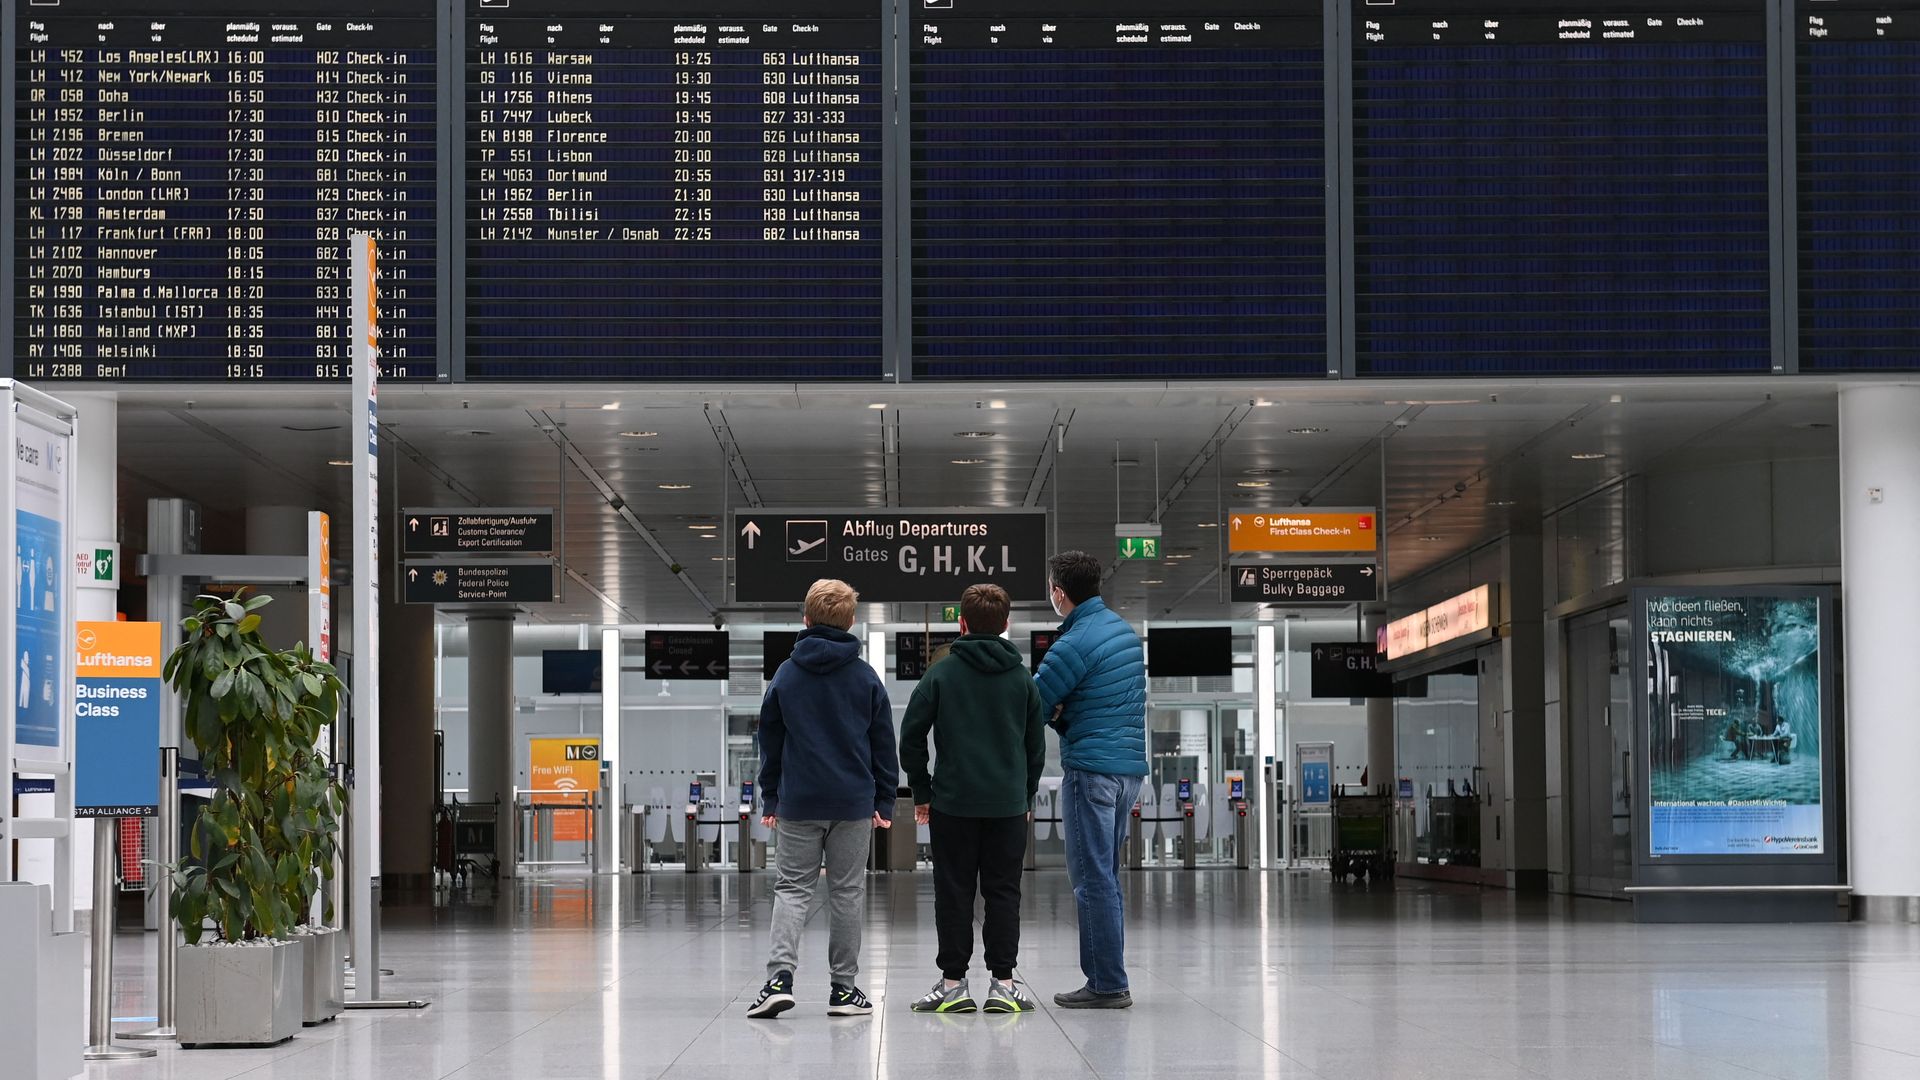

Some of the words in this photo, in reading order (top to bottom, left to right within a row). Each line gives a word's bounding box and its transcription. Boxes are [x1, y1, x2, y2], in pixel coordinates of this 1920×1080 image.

[29, 21, 45, 32] Flug
[97, 21, 114, 30] nach
[150, 21, 166, 31] über
[226, 22, 260, 32] planmäßig
[316, 22, 332, 31] Gate
[1809, 15, 1824, 26] Flug
[1875, 15, 1893, 24] nach
[923, 24, 938, 34] Flug
[990, 23, 1006, 32] nach
[1041, 23, 1057, 32] über
[1115, 22, 1150, 33] planmäßig
[1204, 22, 1220, 31] Gate
[1809, 27, 1828, 38] Flight
[1876, 28, 1885, 36] to
[29, 32, 49, 43] Flight
[98, 34, 106, 42] to
[151, 33, 162, 42] via
[226, 33, 259, 43] scheduled
[271, 34, 304, 43] estimated
[923, 35, 942, 46] Flight
[990, 36, 998, 44] to
[1042, 35, 1053, 43] via
[1116, 34, 1148, 43] scheduled
[1160, 34, 1192, 43] estimated
[480, 51, 495, 65] LH
[504, 51, 533, 65] 1616
[547, 51, 592, 65] Warsaw
[675, 52, 711, 65] 19:25
[792, 52, 860, 66] Lufthansa
[30, 69, 46, 83] LH
[60, 69, 83, 83] 412
[98, 69, 121, 83] New
[129, 69, 211, 83] York/Newark
[228, 70, 264, 84] 16:05
[316, 70, 339, 84] H14
[346, 70, 407, 84] Check-in
[480, 90, 496, 104] LH
[504, 90, 533, 104] 1756
[547, 90, 592, 104] Athens
[675, 91, 711, 104] 19:45
[793, 91, 860, 105] Lufthansa
[30, 108, 46, 122] LH
[54, 108, 83, 122] 1952
[98, 108, 144, 122] Berlin
[228, 109, 264, 123] 17:30
[347, 110, 407, 123] Check-in
[30, 128, 46, 141] LH
[53, 128, 83, 142] 2196
[98, 128, 144, 142] Bremen
[228, 129, 264, 142] 17:30
[347, 129, 407, 143] Check-in
[30, 147, 45, 161] LH
[52, 147, 83, 161] 2022
[98, 147, 172, 161] Düsseldorf
[228, 148, 264, 162] 17:30
[346, 149, 407, 162] Check-in
[480, 149, 496, 162] TP
[510, 149, 531, 162] 551
[547, 149, 593, 163] Lisbon
[674, 149, 711, 163] 20:00
[793, 150, 860, 163] Lufthansa
[480, 188, 496, 201] LH
[504, 188, 533, 201] 1962
[547, 188, 592, 202] Berlin
[674, 188, 711, 202] 21:30
[793, 188, 860, 202] Lufthansa
[30, 206, 45, 220] KL
[54, 206, 83, 220] 1798
[98, 206, 166, 220] Amsterdam
[228, 207, 264, 221] 17:50
[346, 207, 407, 221] Check-in
[480, 207, 496, 221] LH
[503, 207, 533, 221] 2558
[548, 207, 599, 221] Tbilisi
[674, 208, 712, 221] 22:15
[763, 208, 786, 221] H38
[793, 208, 860, 221] Lufthansa
[29, 245, 45, 259] LH
[52, 246, 83, 259] 2102
[97, 246, 158, 260] Hannover
[227, 246, 264, 260] 18:05
[29, 285, 45, 298] EW
[53, 285, 83, 299] 1990
[97, 285, 135, 299] Palma
[143, 285, 218, 299] d.Mallorca
[227, 285, 264, 299] 18:20
[29, 344, 44, 357] AY
[53, 344, 82, 358] 1406
[97, 344, 156, 358] Helsinki
[227, 344, 264, 358] 18:50
[26, 445, 38, 466] care
[458, 516, 537, 527] Zollabfertigung/Ausfuhr
[1269, 518, 1311, 526] Lufthansa
[458, 527, 487, 536] Customs
[489, 527, 525, 536] Clearance/
[843, 520, 894, 540] Abflug
[899, 520, 987, 539] Departures
[1270, 527, 1289, 536] First
[1290, 527, 1312, 536] Class
[1313, 527, 1351, 536] Check-in
[458, 538, 480, 548] Export
[481, 537, 522, 547] Certification
[844, 546, 888, 562] Gates
[458, 568, 509, 577] Bundespolizei
[1262, 567, 1333, 582] Sperrgepäck
[458, 579, 485, 587] Federal
[487, 579, 509, 587] Police
[1263, 583, 1294, 597] Bulky
[1297, 583, 1345, 597] Baggage
[458, 590, 507, 598] Service-Point
[1650, 601, 1668, 612] Wo
[1672, 601, 1700, 611] Ideen
[1705, 600, 1743, 613] fließen,
[1651, 616, 1677, 627] kann
[1681, 616, 1713, 626] nichts
[1651, 631, 1735, 642] STAGNIEREN.
[76, 652, 153, 668] Lufthansa
[76, 684, 147, 700] Business
[76, 702, 120, 717] Class
[532, 766, 551, 774] Free
[97, 807, 142, 816] ALLIANCE
